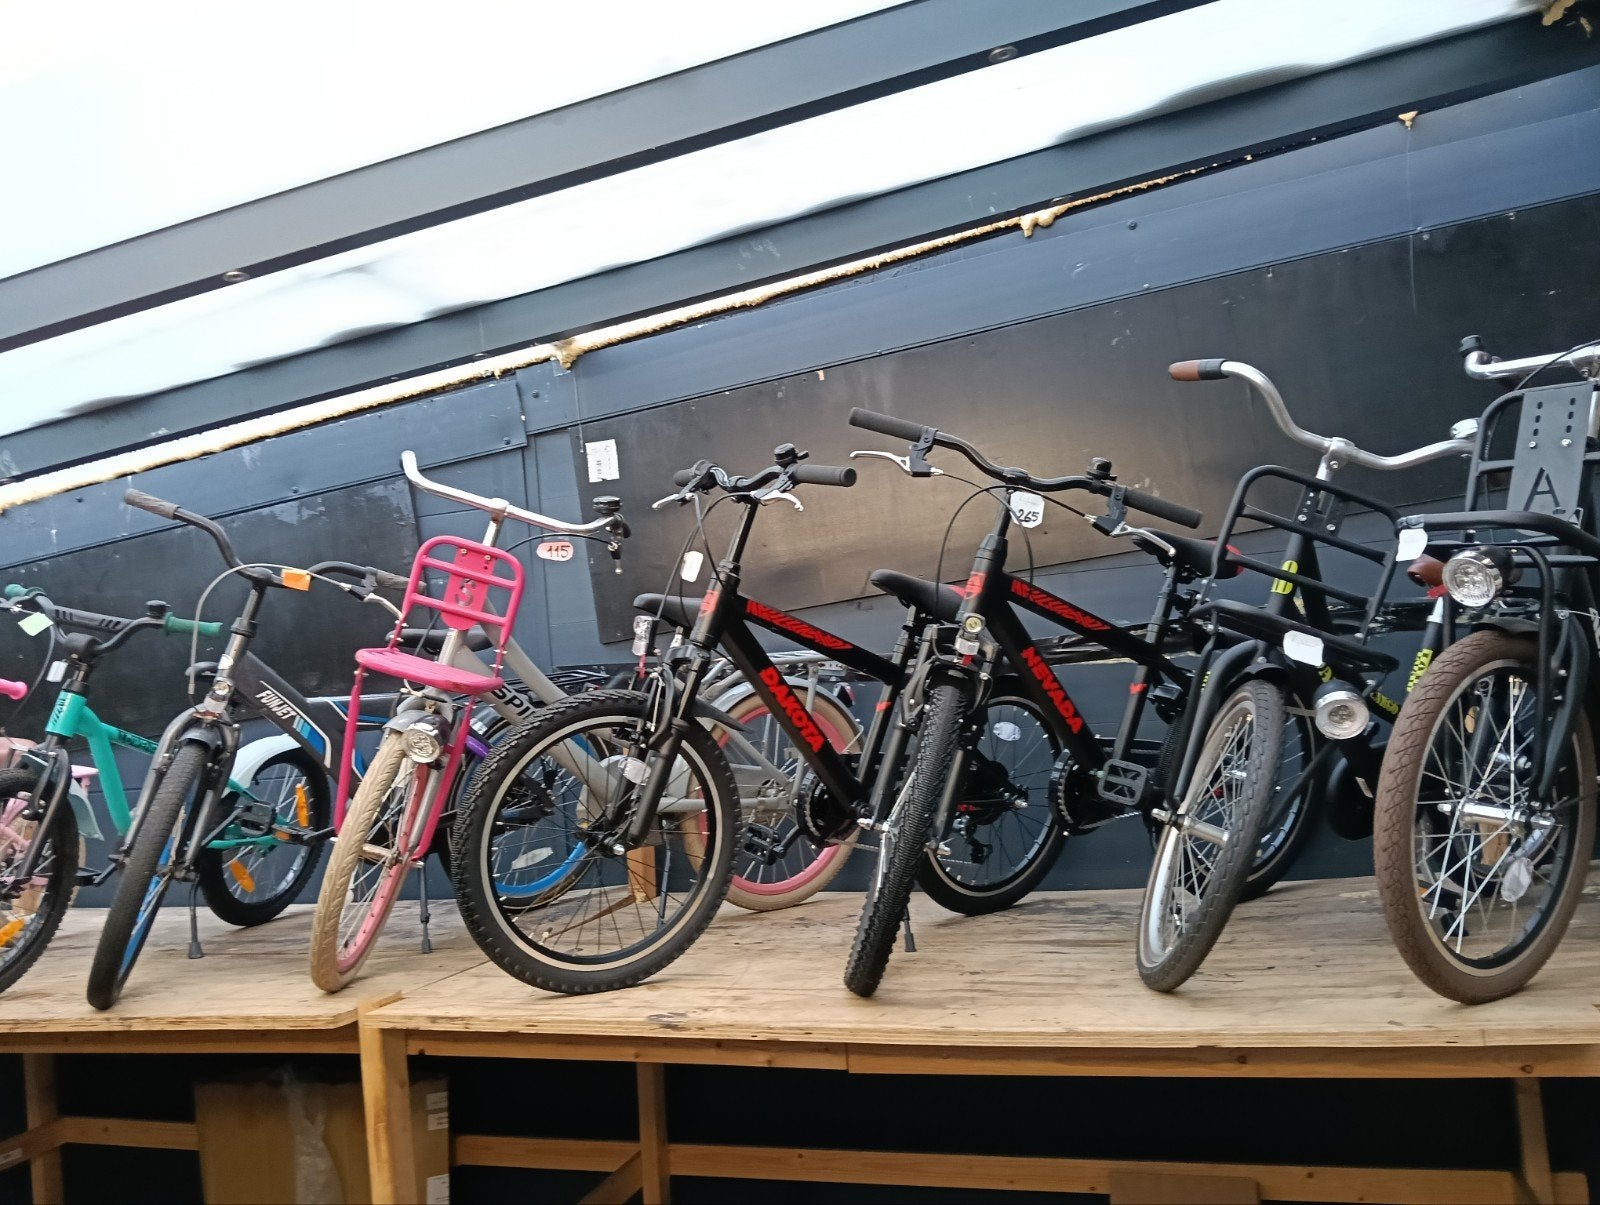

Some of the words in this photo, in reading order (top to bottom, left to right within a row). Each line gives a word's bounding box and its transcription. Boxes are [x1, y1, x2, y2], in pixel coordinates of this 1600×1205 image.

[1018, 509, 1039, 522] 265
[547, 545, 570, 558] 115
[255, 690, 298, 720] FUNJET
[1021, 646, 1083, 734] NEVADA
[760, 666, 825, 753] DAKOTA
